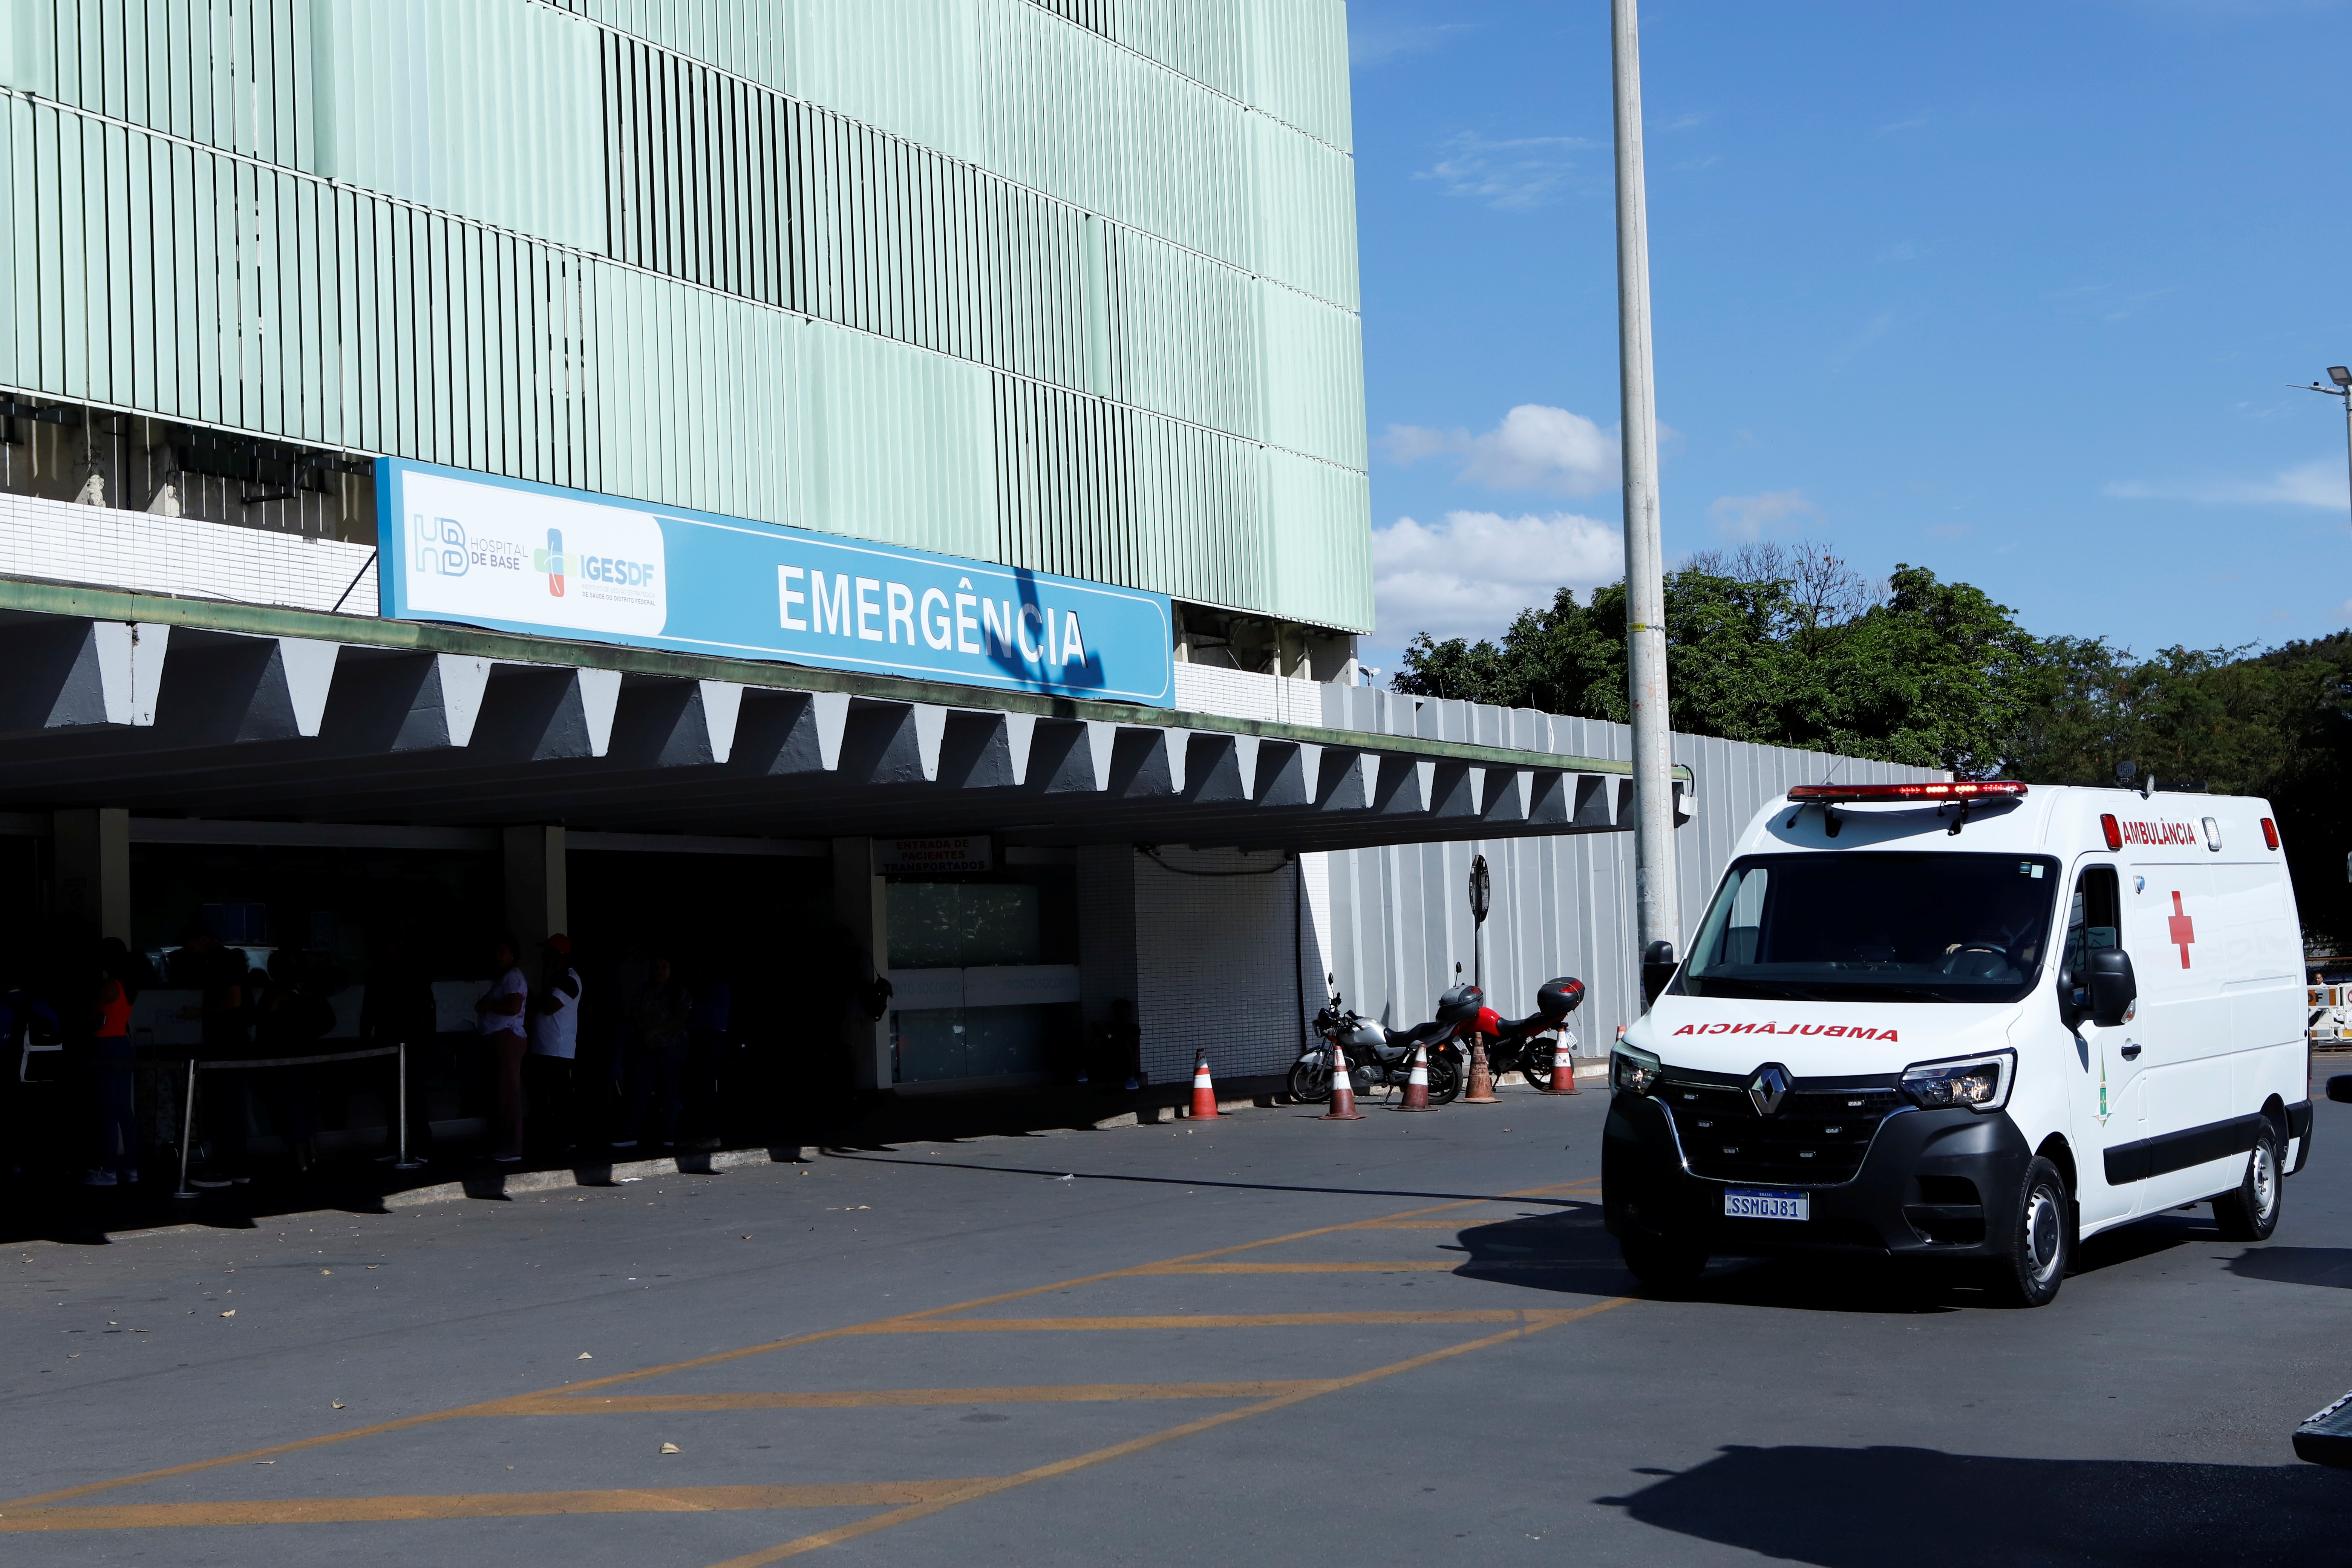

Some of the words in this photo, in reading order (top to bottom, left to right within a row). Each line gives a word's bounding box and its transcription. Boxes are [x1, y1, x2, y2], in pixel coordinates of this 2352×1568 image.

[471, 537, 528, 557] HOSPITAL
[471, 552, 487, 565] DE
[490, 554, 520, 570] BASE
[580, 554, 654, 587] IGESDF
[778, 564, 1089, 668] EMERGÊNCIA
[2122, 817, 2196, 845] AMBULÂNCIA
[896, 840, 950, 850] ENTRADA
[954, 839, 969, 848] DE
[901, 851, 965, 860] PACIENTES
[884, 861, 985, 872] TRANSPORTADOS
[892, 982, 959, 995] ONTO-SOCORRO
[1003, 977, 1076, 991] PRONTO-SOCORRO
